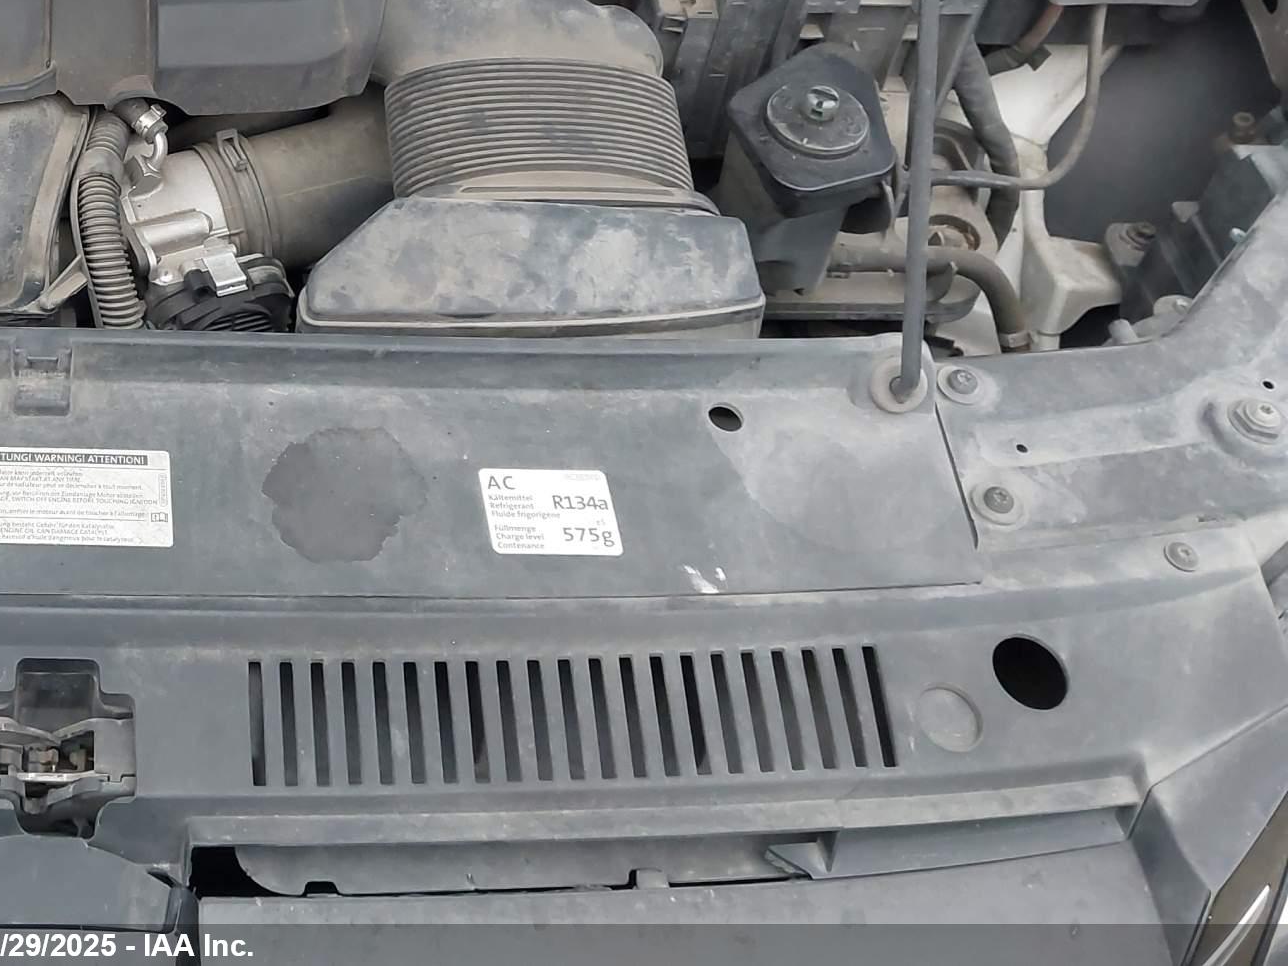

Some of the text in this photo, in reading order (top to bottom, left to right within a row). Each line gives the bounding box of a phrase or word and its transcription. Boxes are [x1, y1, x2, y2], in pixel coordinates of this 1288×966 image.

[33, 453, 86, 464] WARNING!
[87, 455, 145, 465] ATTENTION!
[487, 475, 517, 490] AC
[489, 501, 535, 511] Refrigerant
[551, 494, 610, 511] R134a
[495, 533, 545, 542] Charge level
[562, 527, 616, 548] 575g
[497, 541, 545, 550] Contenance
